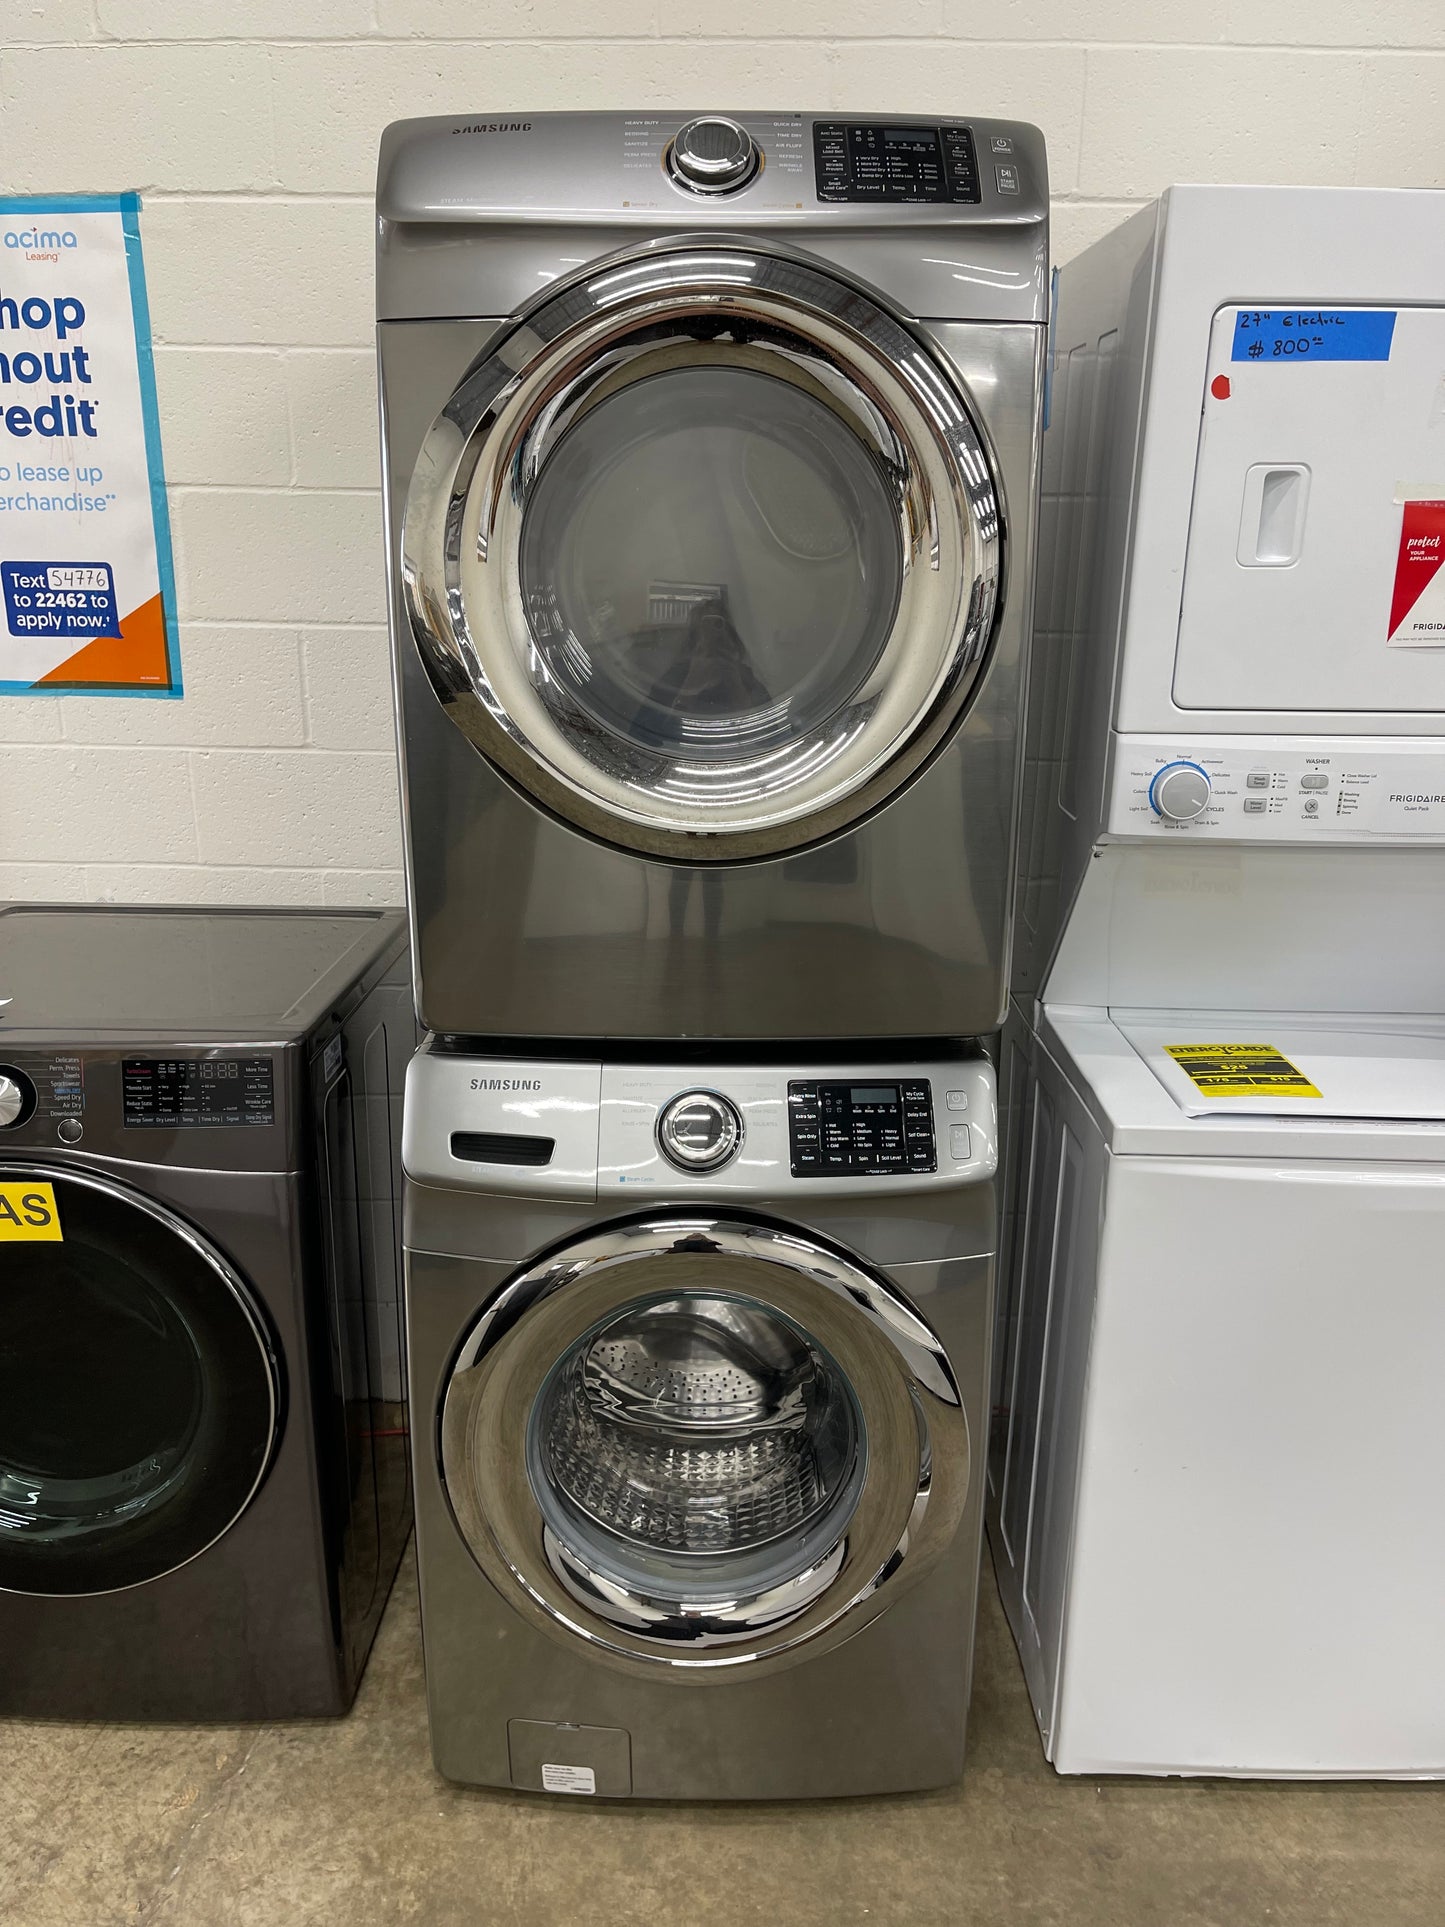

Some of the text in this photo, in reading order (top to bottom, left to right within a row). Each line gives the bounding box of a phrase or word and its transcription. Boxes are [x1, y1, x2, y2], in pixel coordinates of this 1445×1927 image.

[452, 122, 532, 135] SAMSUNG
[4, 227, 78, 249] acima
[25, 250, 60, 263] Leasing
[1247, 341, 1265, 359] $
[17, 462, 70, 482] lease
[76, 466, 104, 486] up
[1407, 535, 1441, 550] protect
[10, 569, 107, 589] Text 54776
[14, 592, 109, 609] to 22462 to
[16, 611, 63, 630] apply
[470, 1078, 541, 1091] SAMSUNG
[71, 1094, 82, 1102] Dry
